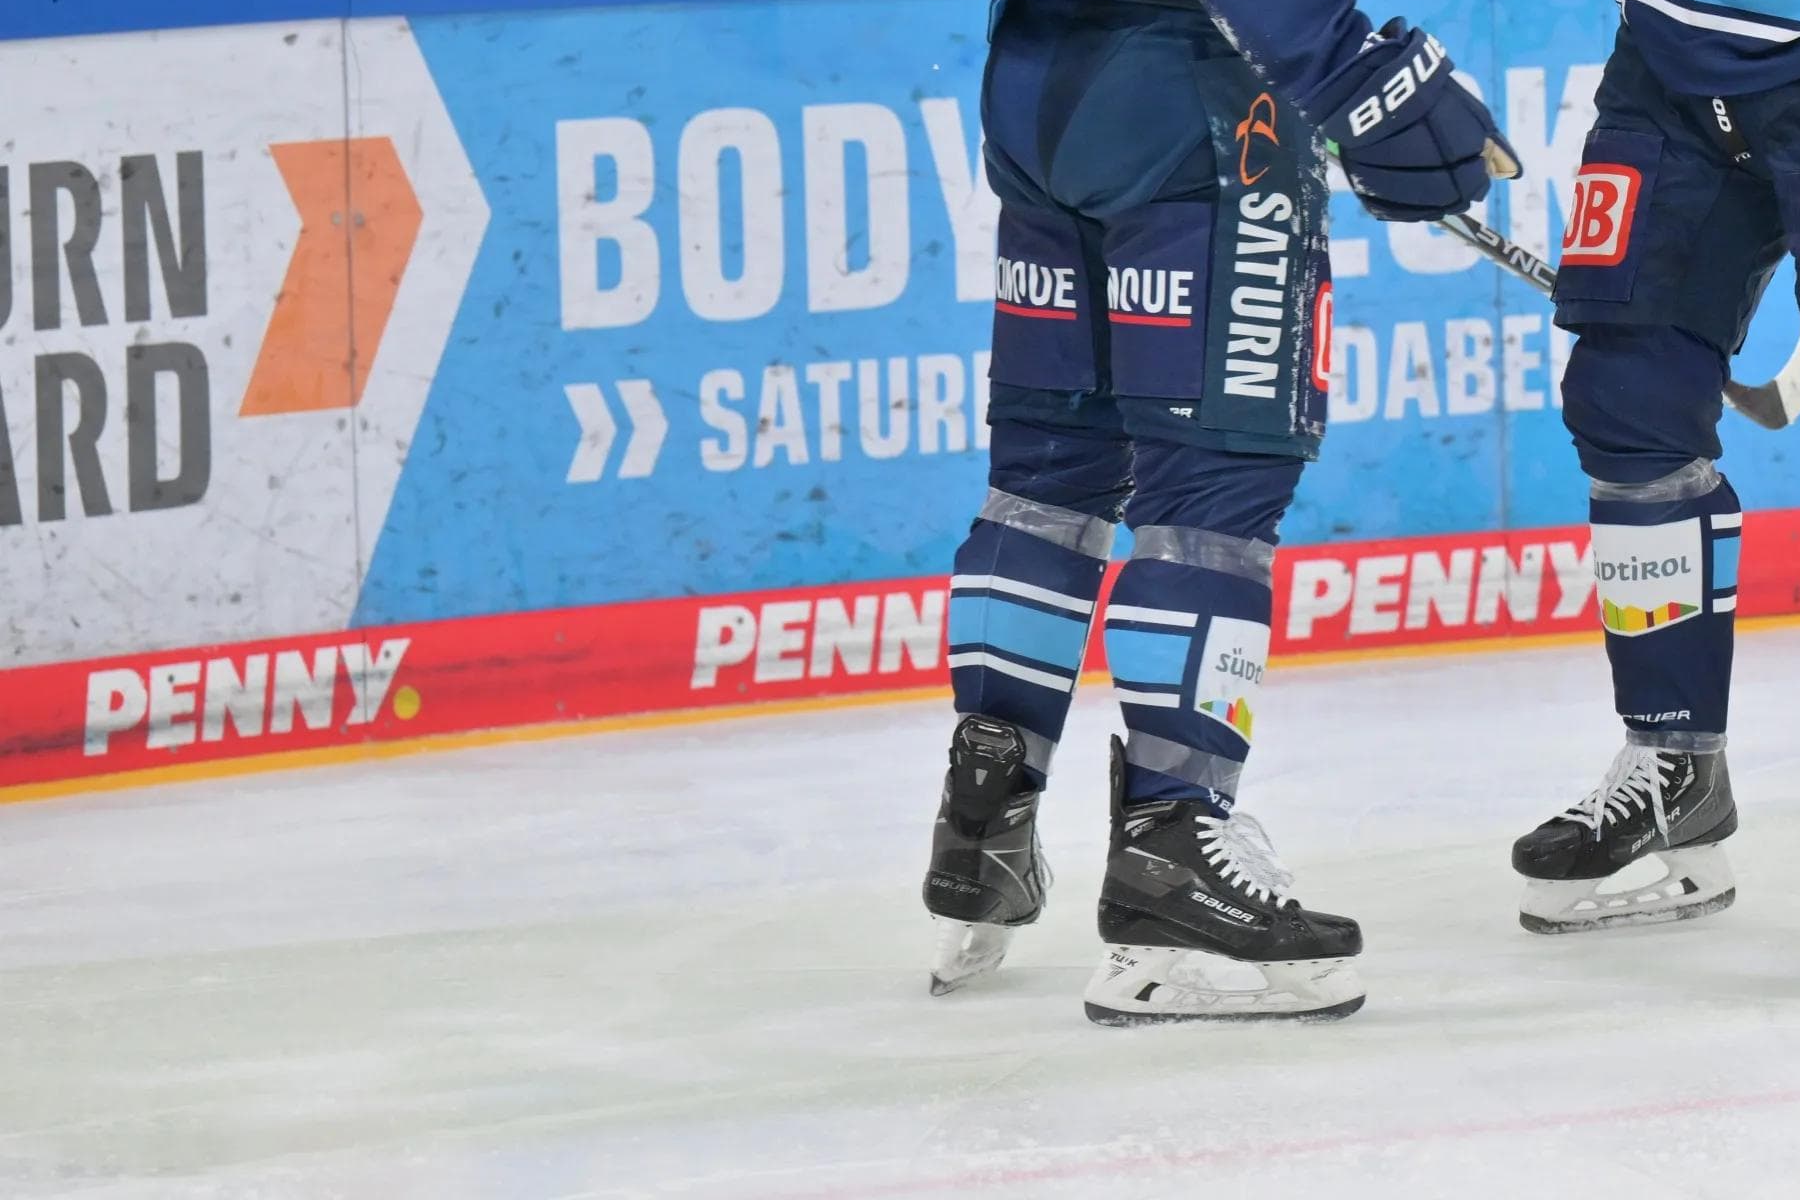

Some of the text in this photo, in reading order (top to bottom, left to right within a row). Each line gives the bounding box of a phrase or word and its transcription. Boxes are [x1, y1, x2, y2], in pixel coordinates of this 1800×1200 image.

[1223, 190, 1293, 400] SATURN
[690, 589, 953, 690] PENN
[1190, 890, 1255, 922] BAUER
